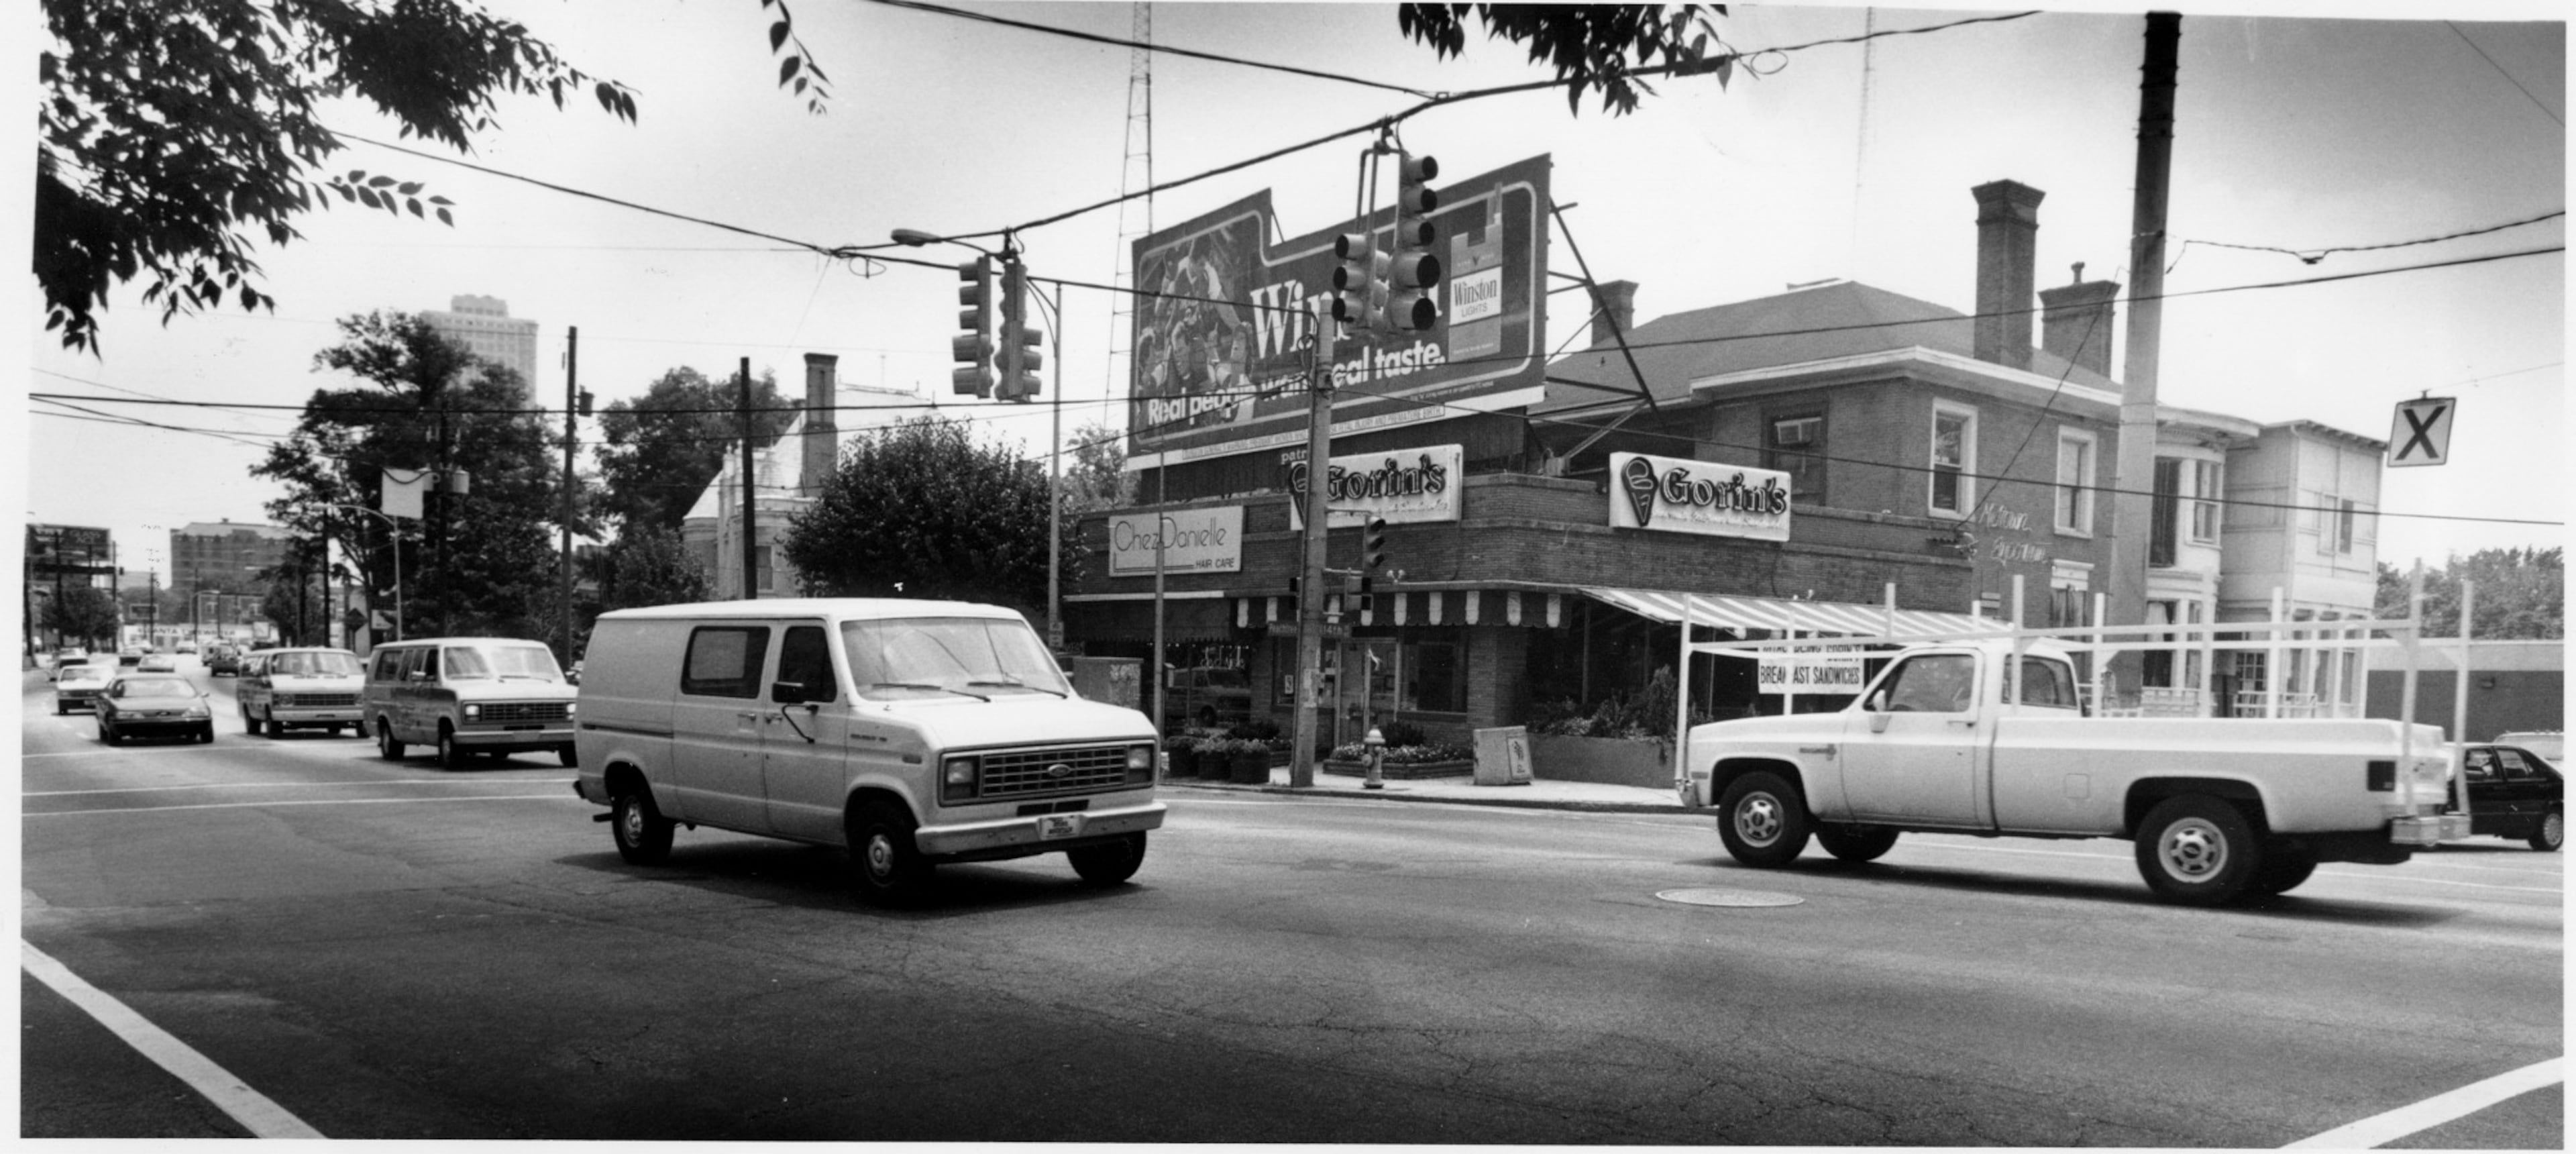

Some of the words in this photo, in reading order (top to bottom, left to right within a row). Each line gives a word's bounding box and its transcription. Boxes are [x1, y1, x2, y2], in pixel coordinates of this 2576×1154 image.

[1454, 278, 1497, 307] Winston
[1461, 303, 1489, 317] LIGHTS
[1148, 386, 1186, 425] Real
[1260, 375, 1308, 402] wan
[1332, 346, 1370, 388] eal
[1375, 339, 1446, 380] taste.
[2395, 405, 2447, 460] X
[1328, 453, 1446, 501] Gorin's
[1660, 467, 1787, 515] Gorin's
[1114, 520, 1159, 552] Chez
[1161, 516, 1227, 549] Danielle
[1195, 560, 1212, 568] HAIR
[1216, 558, 1235, 568] CARE
[1760, 666, 1811, 684] BREAAST
[1813, 666, 1860, 684] SANDWICHES
